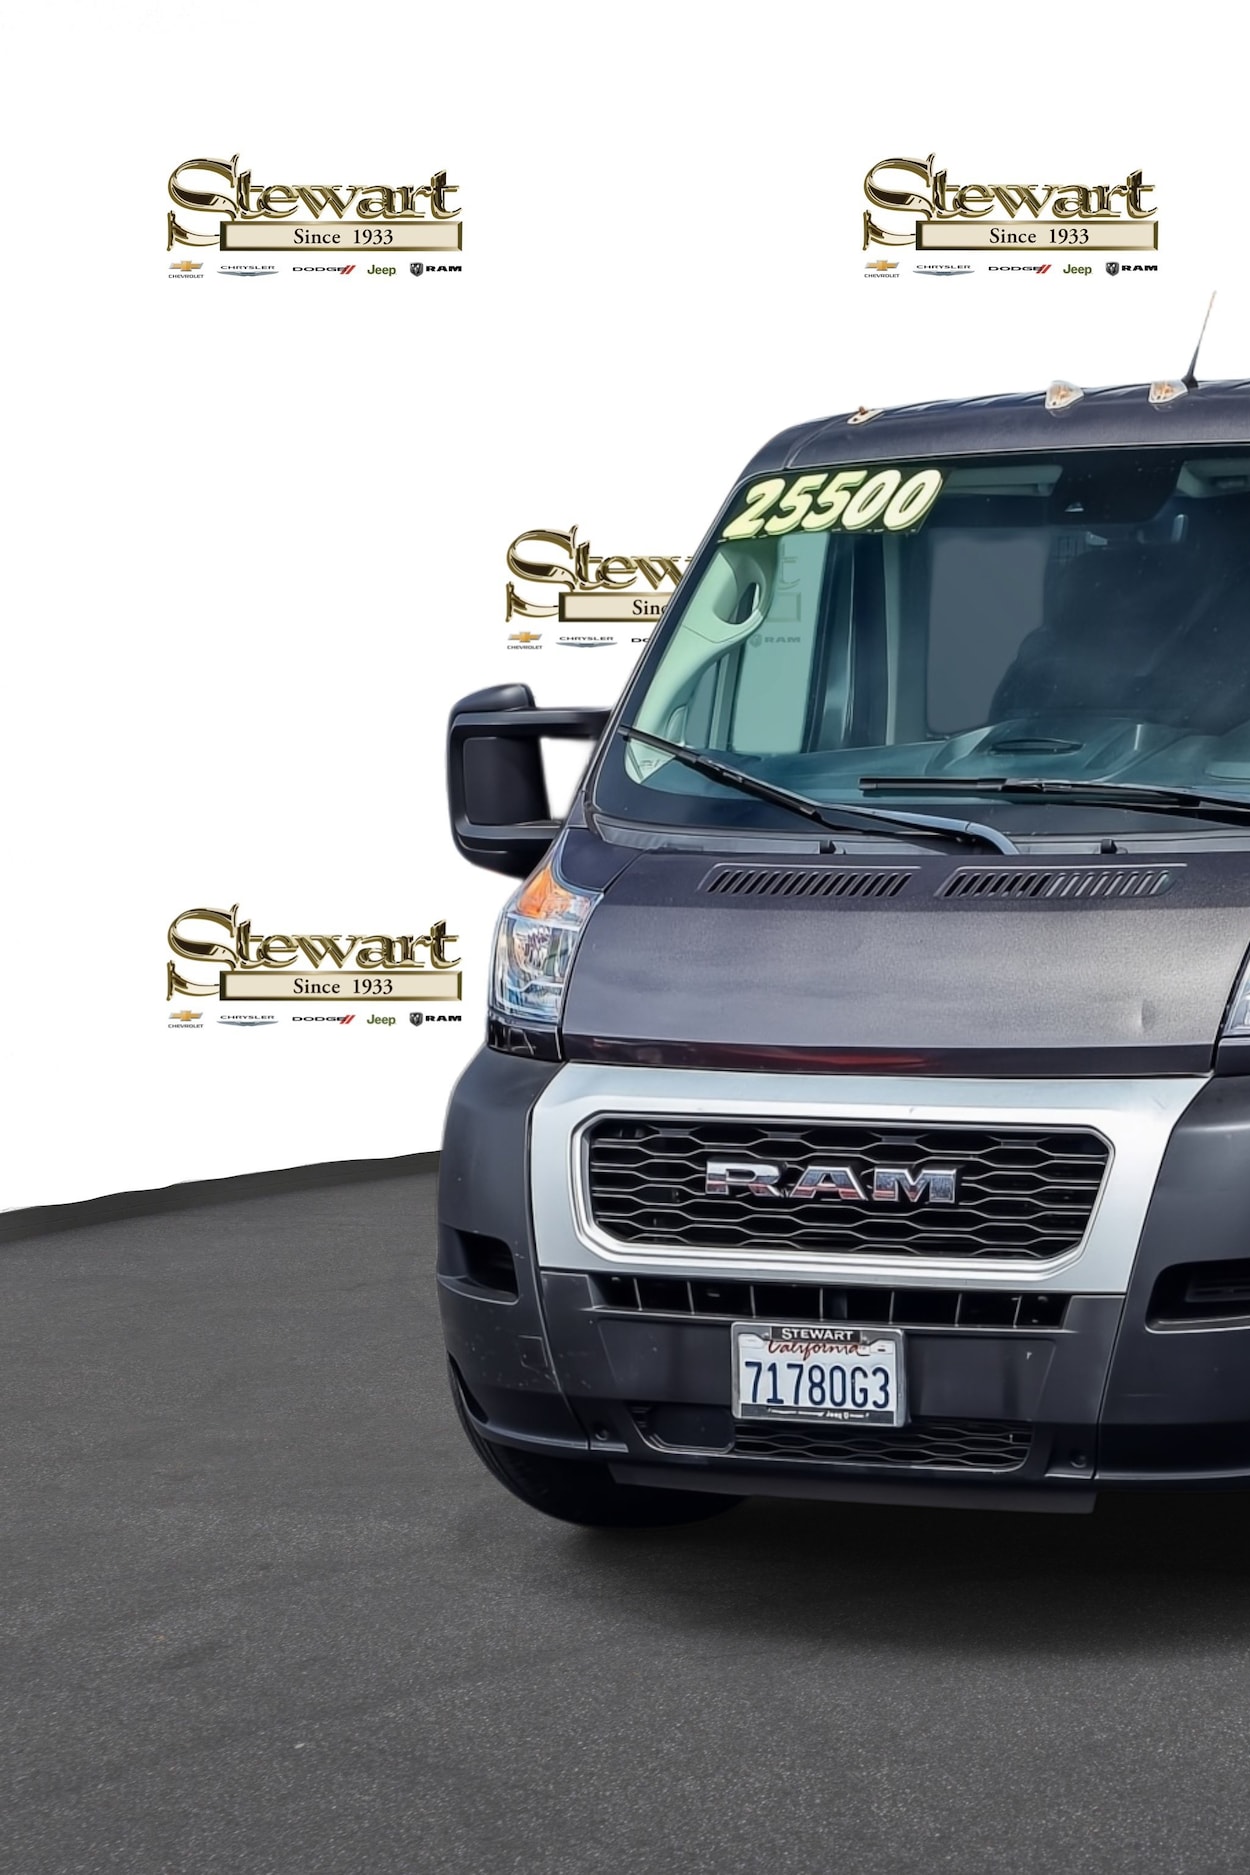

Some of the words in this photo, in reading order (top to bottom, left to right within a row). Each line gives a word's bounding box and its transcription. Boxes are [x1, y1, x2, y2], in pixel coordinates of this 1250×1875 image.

[167, 153, 463, 251] Stewart
[863, 152, 1159, 250] Stewart
[293, 228, 341, 245] Since
[353, 229, 394, 245] 1933
[989, 227, 1037, 244] Since
[1049, 228, 1090, 244] 1933
[367, 264, 397, 277] Jeep
[425, 265, 463, 273] RAM
[1063, 263, 1093, 276] Jeep
[1121, 264, 1159, 272] RAM
[722, 470, 943, 538] 25500
[506, 524, 693, 622] Stew
[764, 636, 801, 644] RAM
[167, 903, 463, 1001] Stewart
[293, 978, 341, 995] Since
[353, 979, 394, 995] 1933
[367, 1014, 397, 1027] Jeep
[425, 1015, 463, 1023] RAM
[705, 1160, 958, 1204] RAM
[781, 1327, 854, 1341] STEWART
[767, 1339, 870, 1361] California
